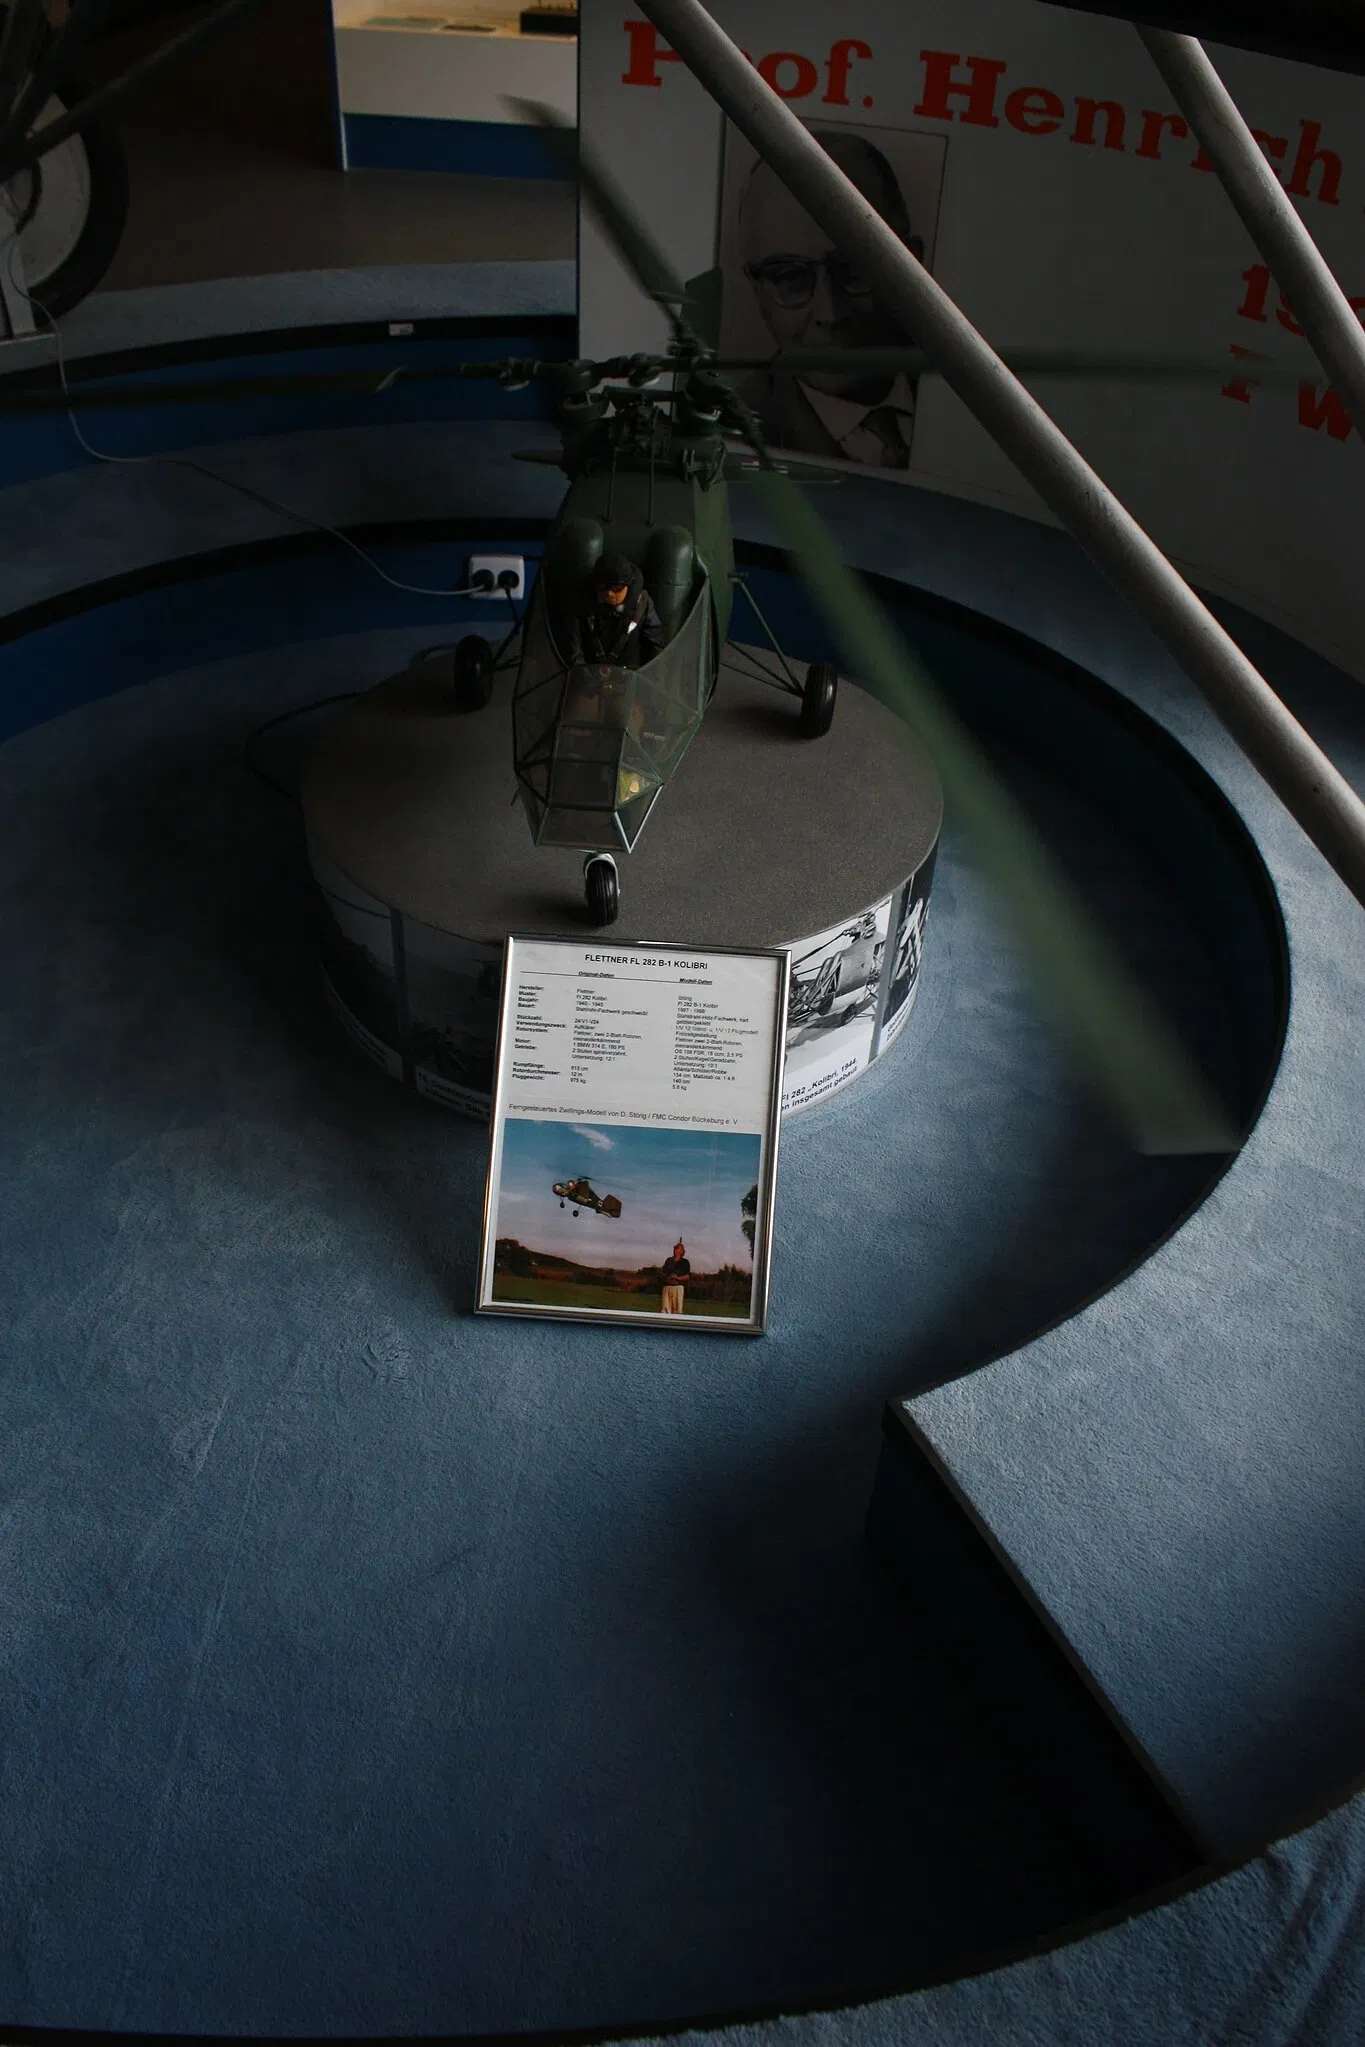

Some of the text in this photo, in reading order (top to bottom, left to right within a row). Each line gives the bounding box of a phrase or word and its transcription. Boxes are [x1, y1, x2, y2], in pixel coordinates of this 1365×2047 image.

[621, 20, 873, 109] Pof.
[585, 954, 708, 969] FLETTNER FL 282 B-1 KOLIBRI
[791, 1087, 806, 1098] 282
[792, 1082, 832, 1106] insgesamt
[834, 1066, 858, 1087] gebaut
[509, 1104, 557, 1113] Ferngesteuertes
[559, 1107, 607, 1117] Zwillings-Modell
[668, 1114, 690, 1122] Condor
[692, 1116, 724, 1125] Bückeburg
